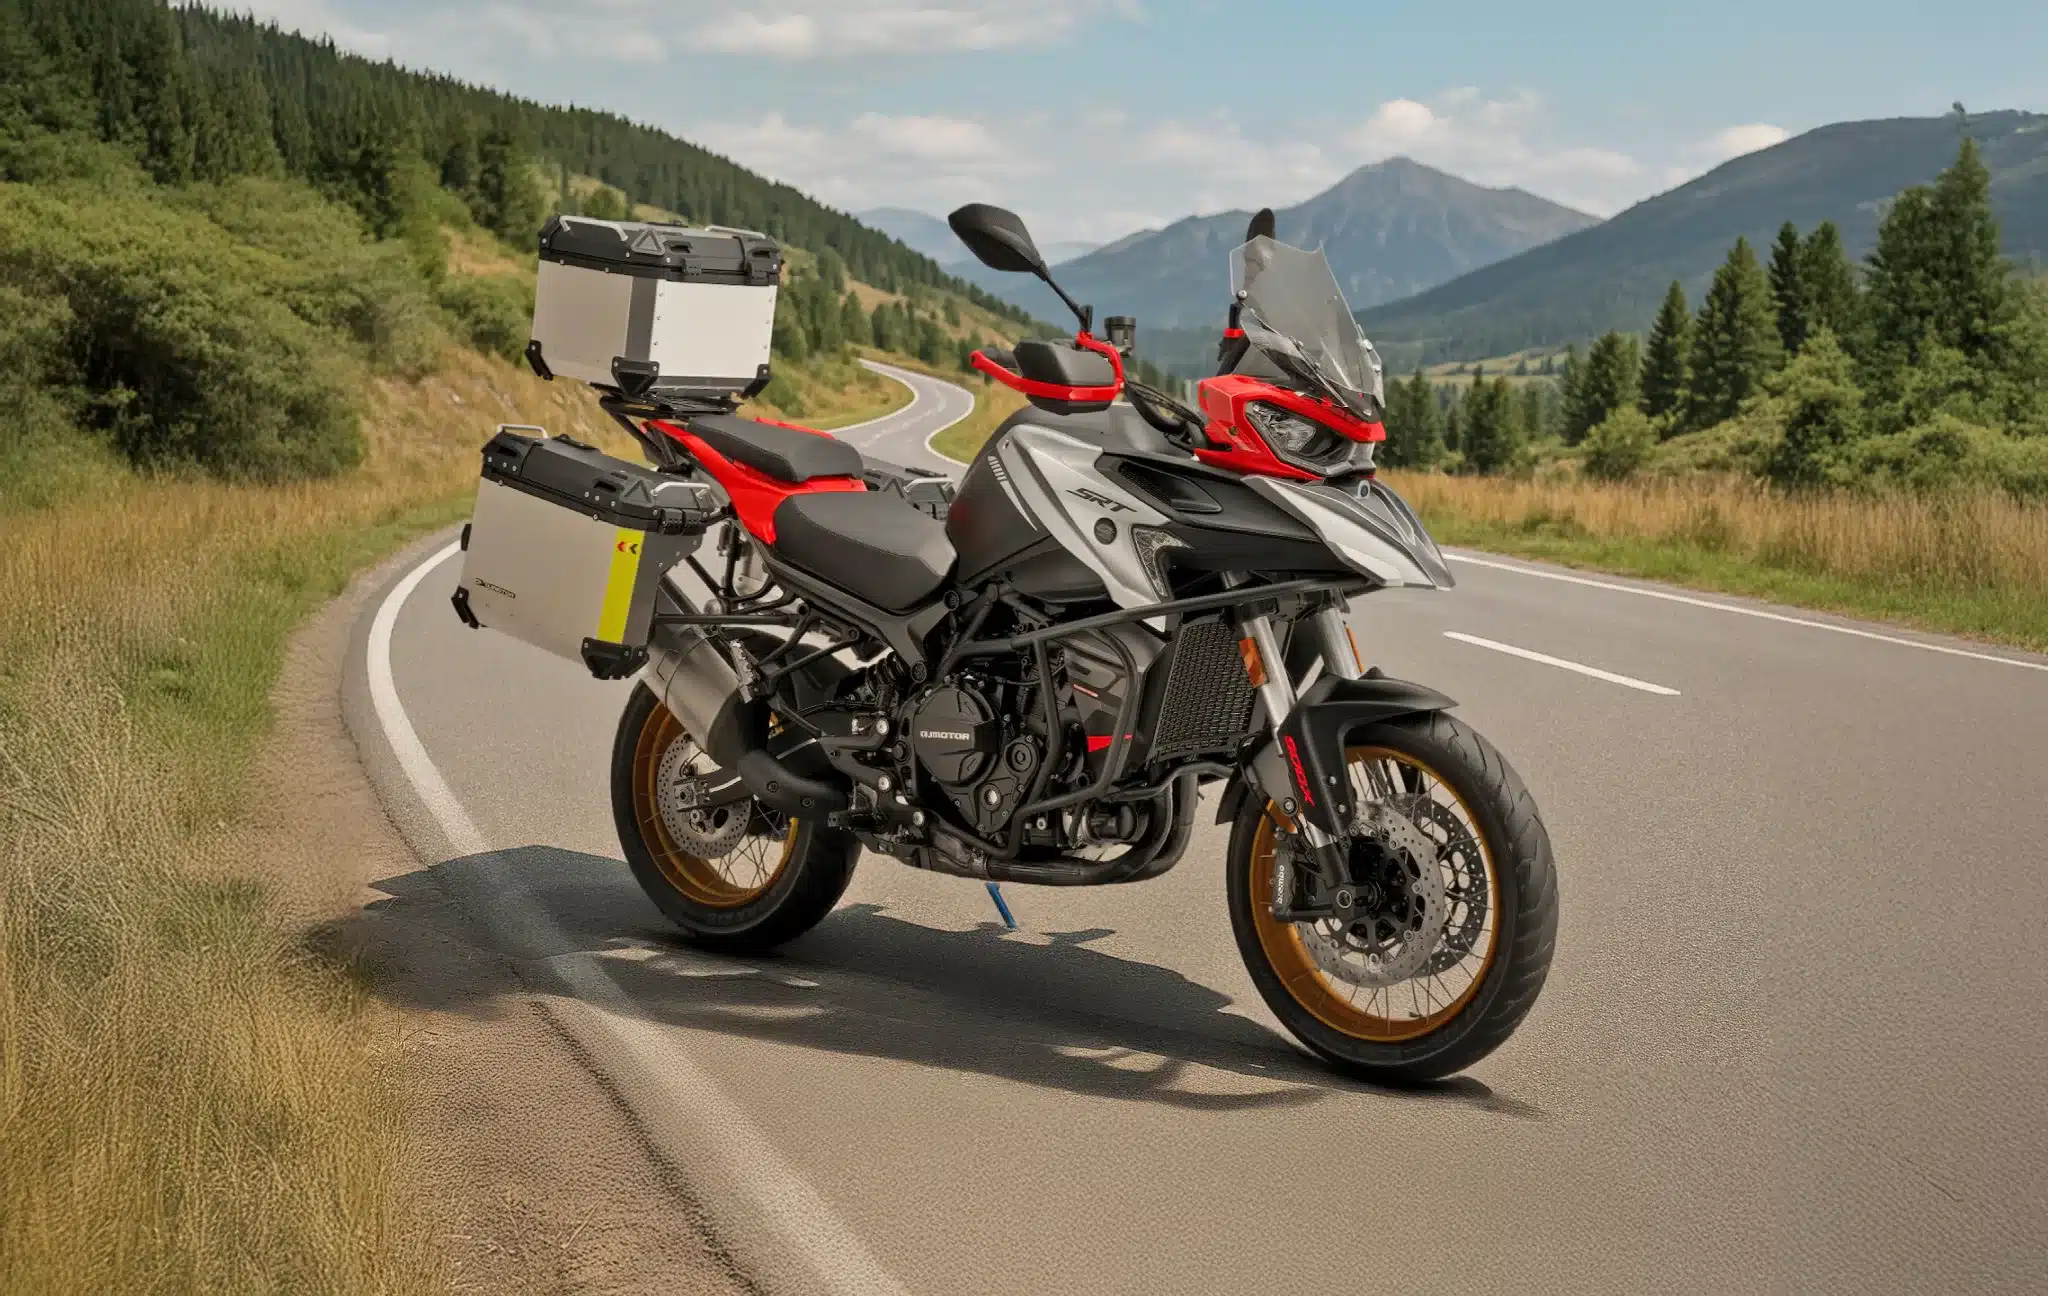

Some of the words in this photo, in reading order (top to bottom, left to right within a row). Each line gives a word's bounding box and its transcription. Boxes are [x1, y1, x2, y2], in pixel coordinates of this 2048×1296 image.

[1065, 487, 1138, 512] SRT
[919, 730, 971, 741] QJMOTOR
[1275, 864, 1285, 905] brembo
